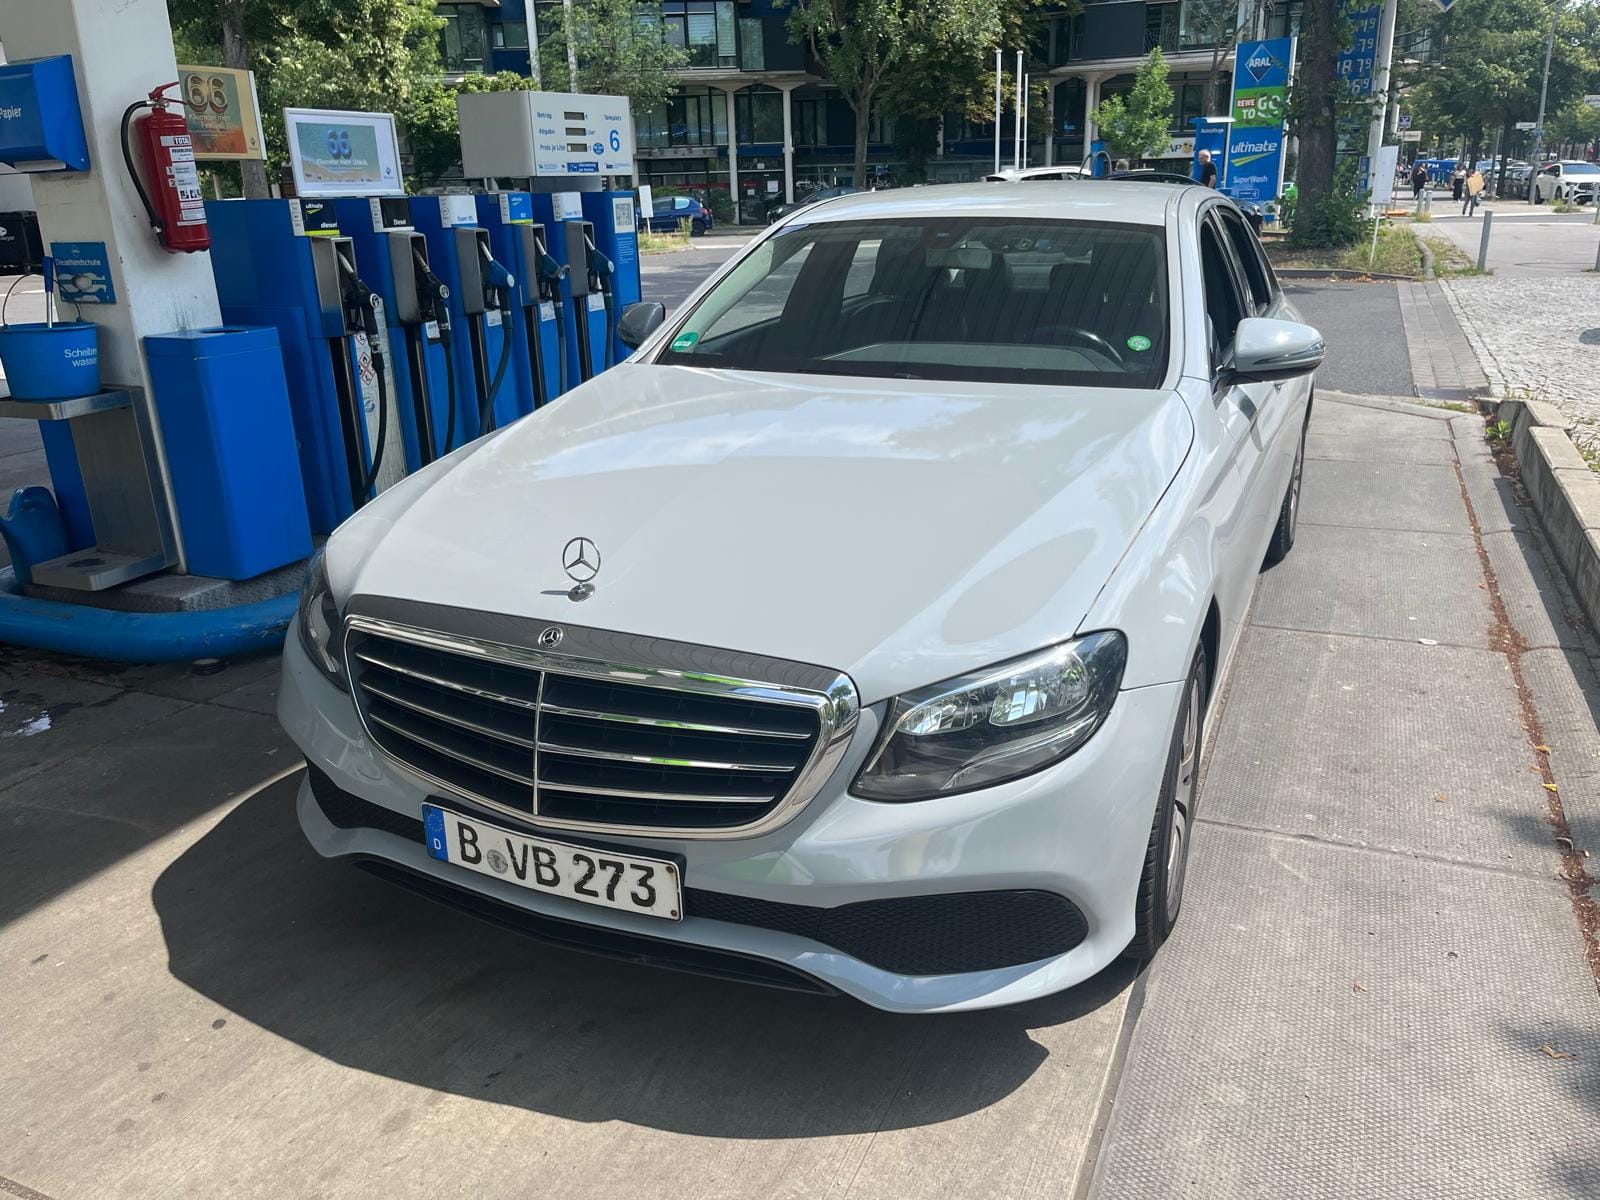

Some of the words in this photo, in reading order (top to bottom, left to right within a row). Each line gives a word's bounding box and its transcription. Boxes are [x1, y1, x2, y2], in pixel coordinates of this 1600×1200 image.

[1249, 57, 1271, 67] ARAL
[185, 74, 228, 113] 66
[1237, 99, 1255, 107] REWE
[1242, 109, 1256, 119] TO
[609, 129, 620, 152] 6
[1231, 140, 1278, 153] ultimate
[1233, 175, 1268, 184] SuperWash
[433, 838, 442, 850] D
[457, 821, 482, 865] B
[505, 838, 561, 888] VB
[572, 853, 657, 908] 273
